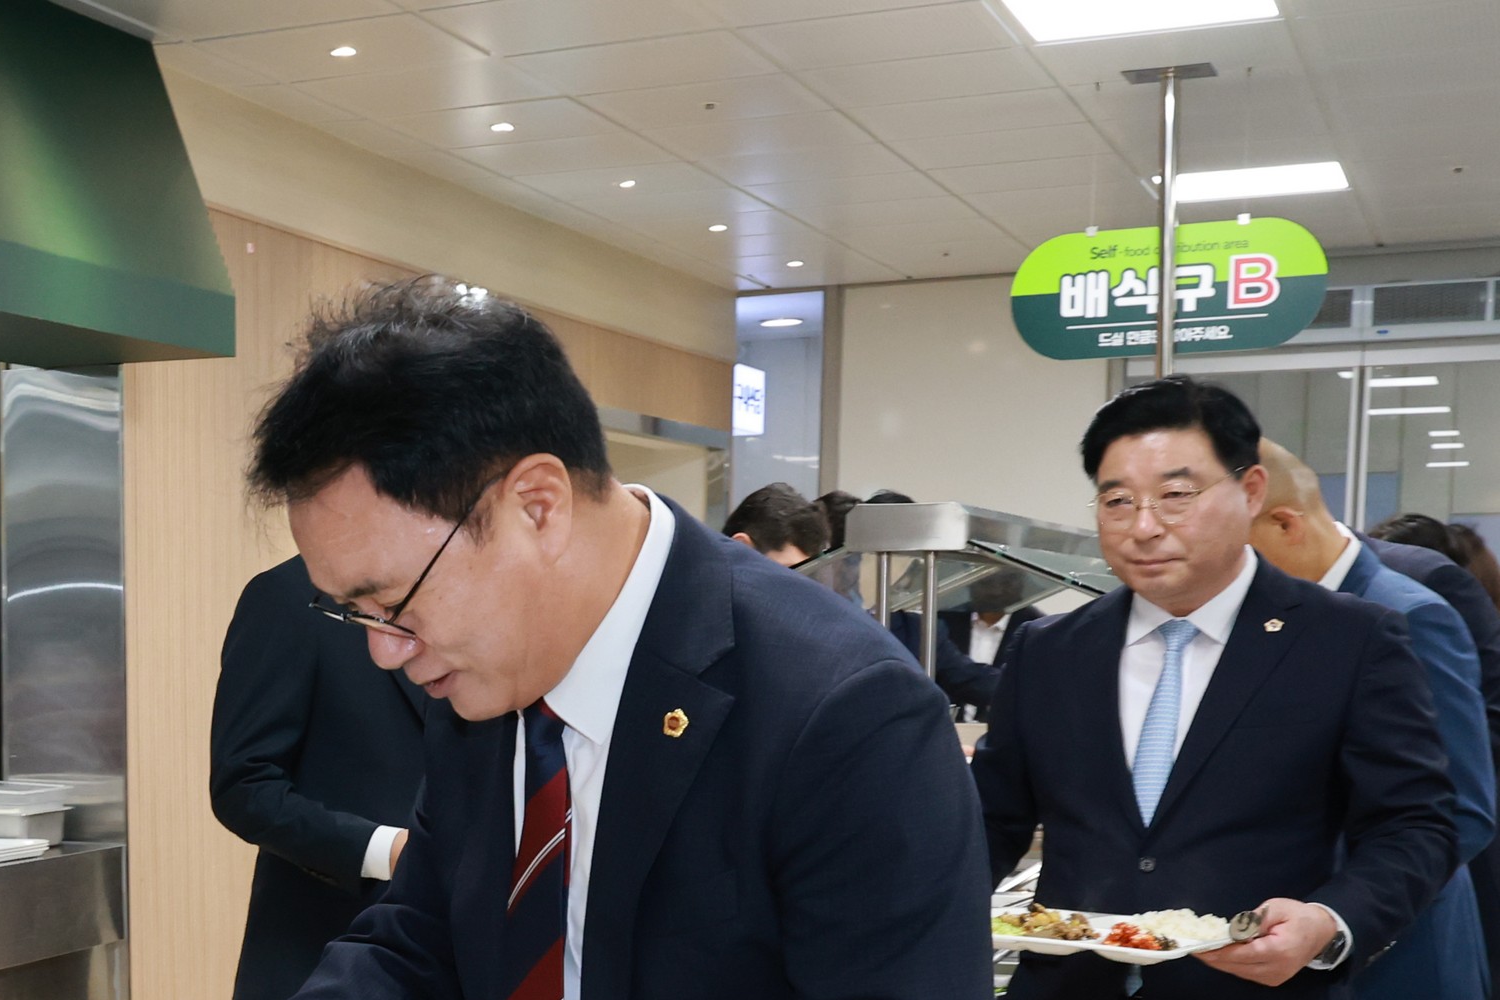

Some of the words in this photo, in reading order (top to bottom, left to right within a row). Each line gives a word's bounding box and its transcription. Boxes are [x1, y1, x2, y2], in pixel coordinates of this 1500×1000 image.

[1223, 239, 1249, 250] area
[1060, 263, 1216, 319] 배식구
[1227, 253, 1281, 309] B
